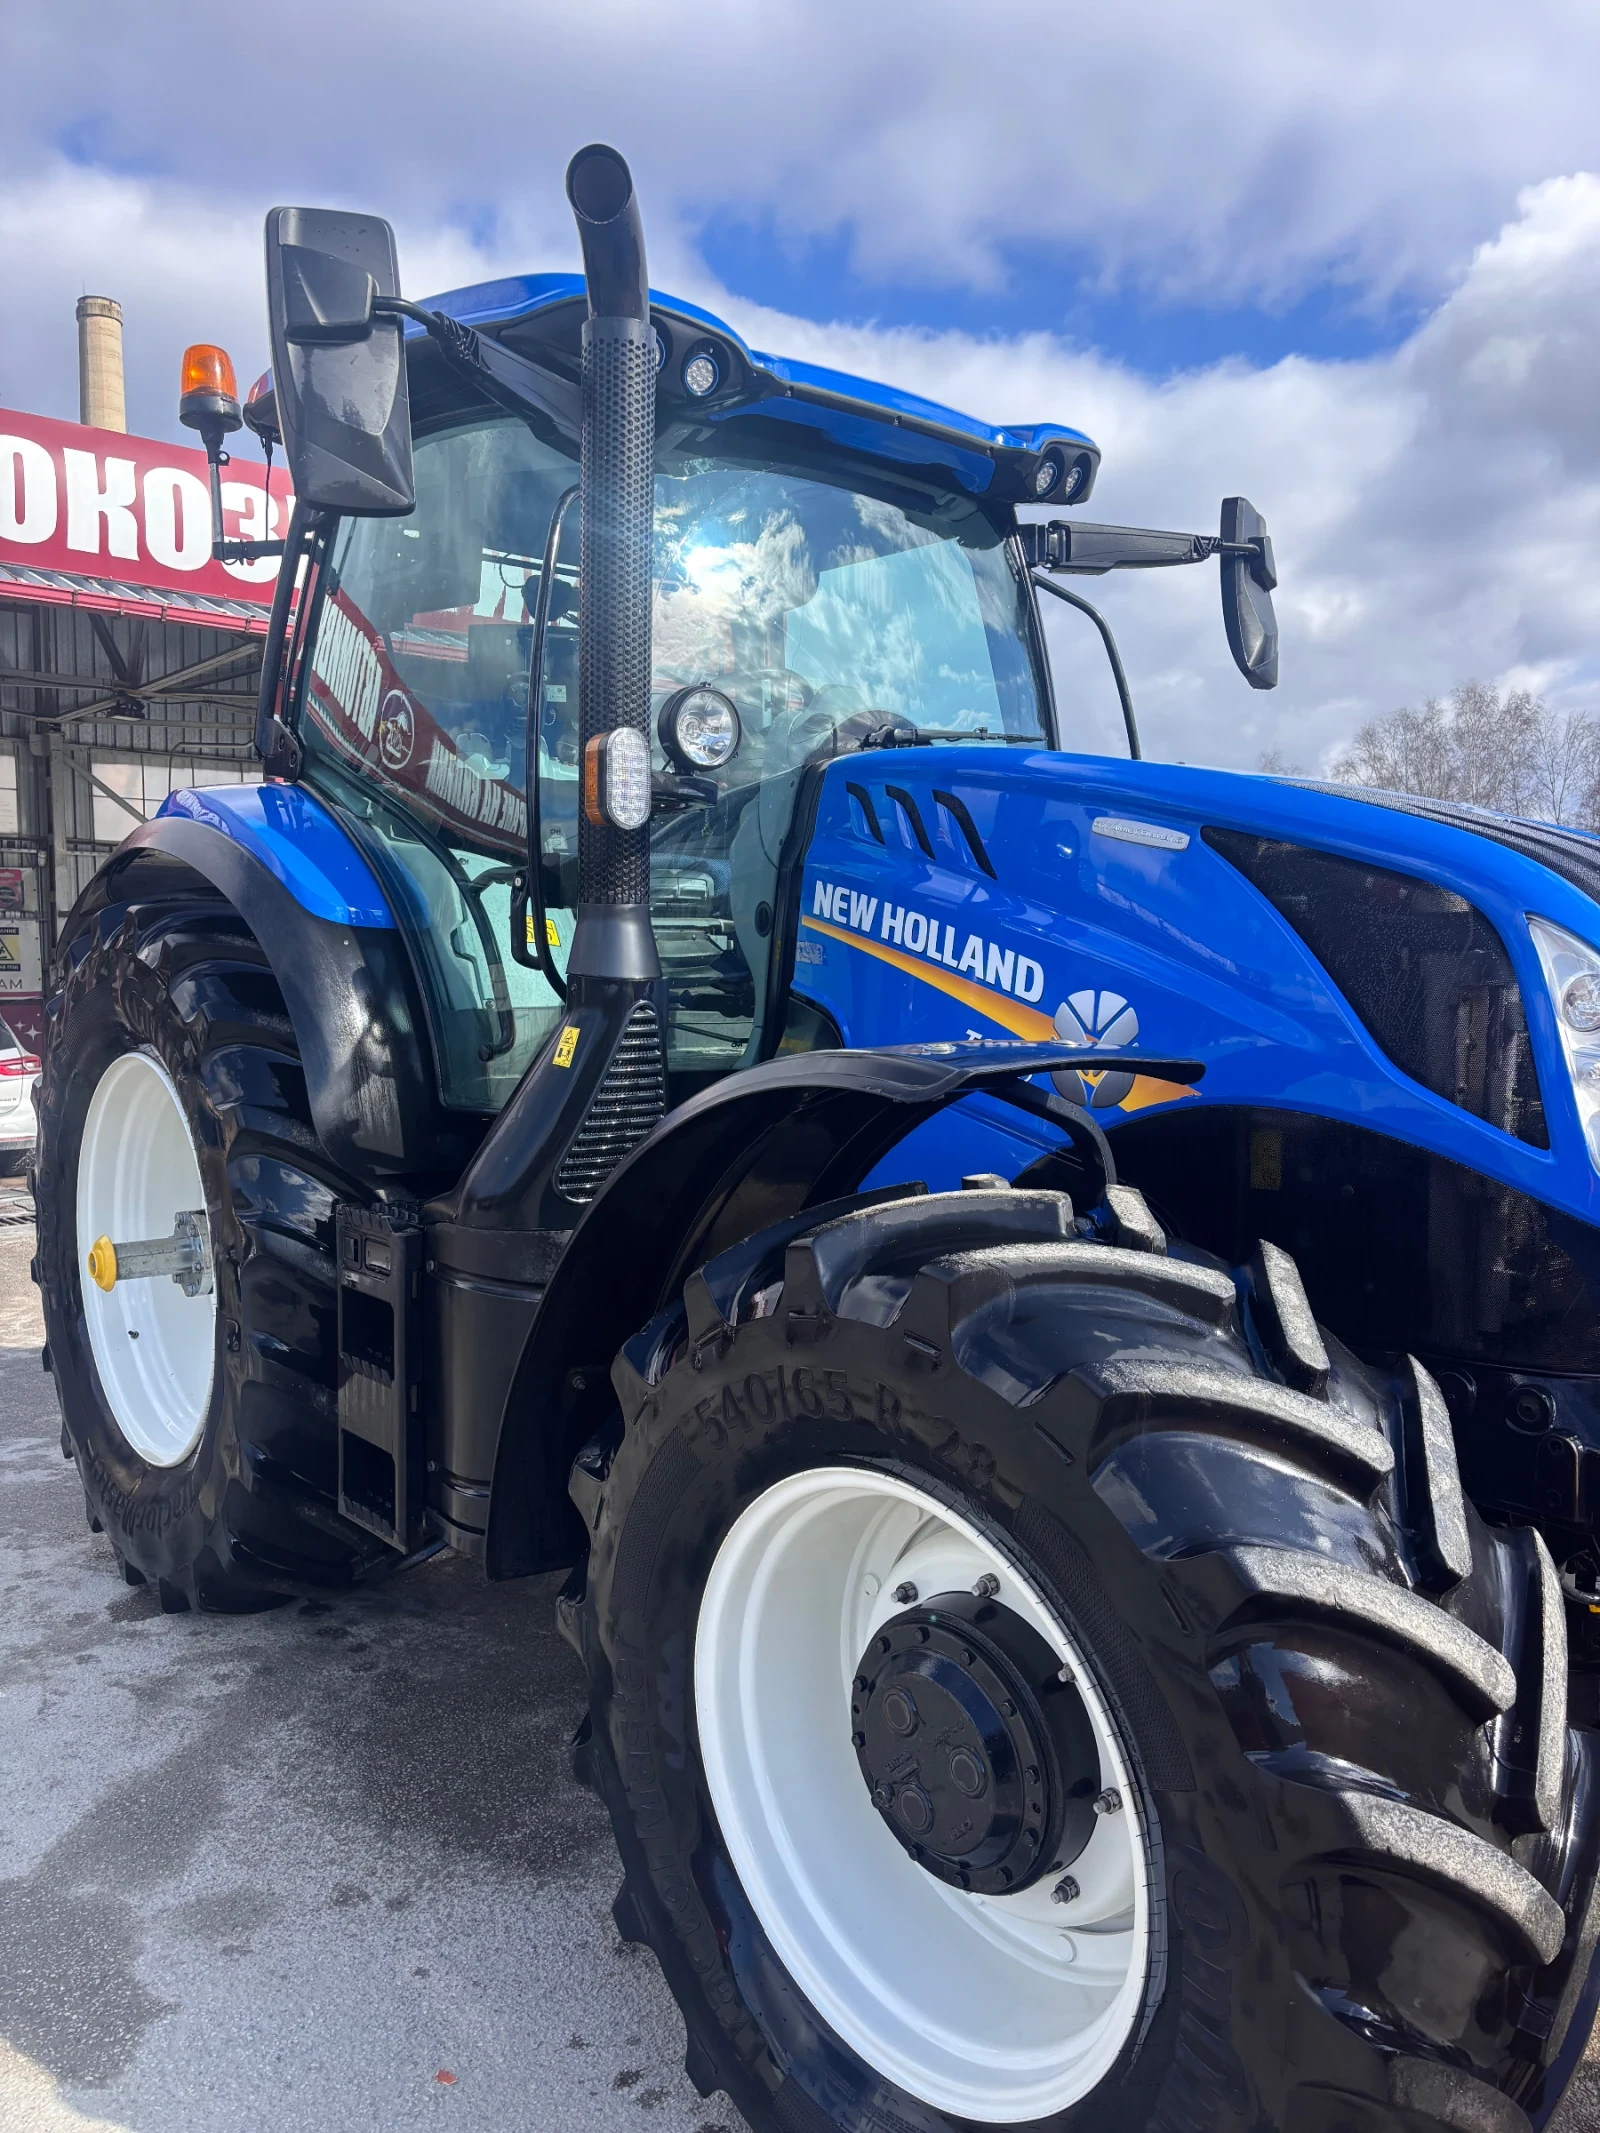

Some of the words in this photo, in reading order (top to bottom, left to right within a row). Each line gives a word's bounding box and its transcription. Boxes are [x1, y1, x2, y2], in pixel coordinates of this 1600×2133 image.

[0, 434, 309, 588] ОКОЗ
[812, 880, 878, 933] NEW
[880, 902, 1045, 1004] HOLLAND
[696, 1363, 855, 1451] 540/65
[875, 1380, 908, 1445] R
[930, 1415, 998, 1501] 28
